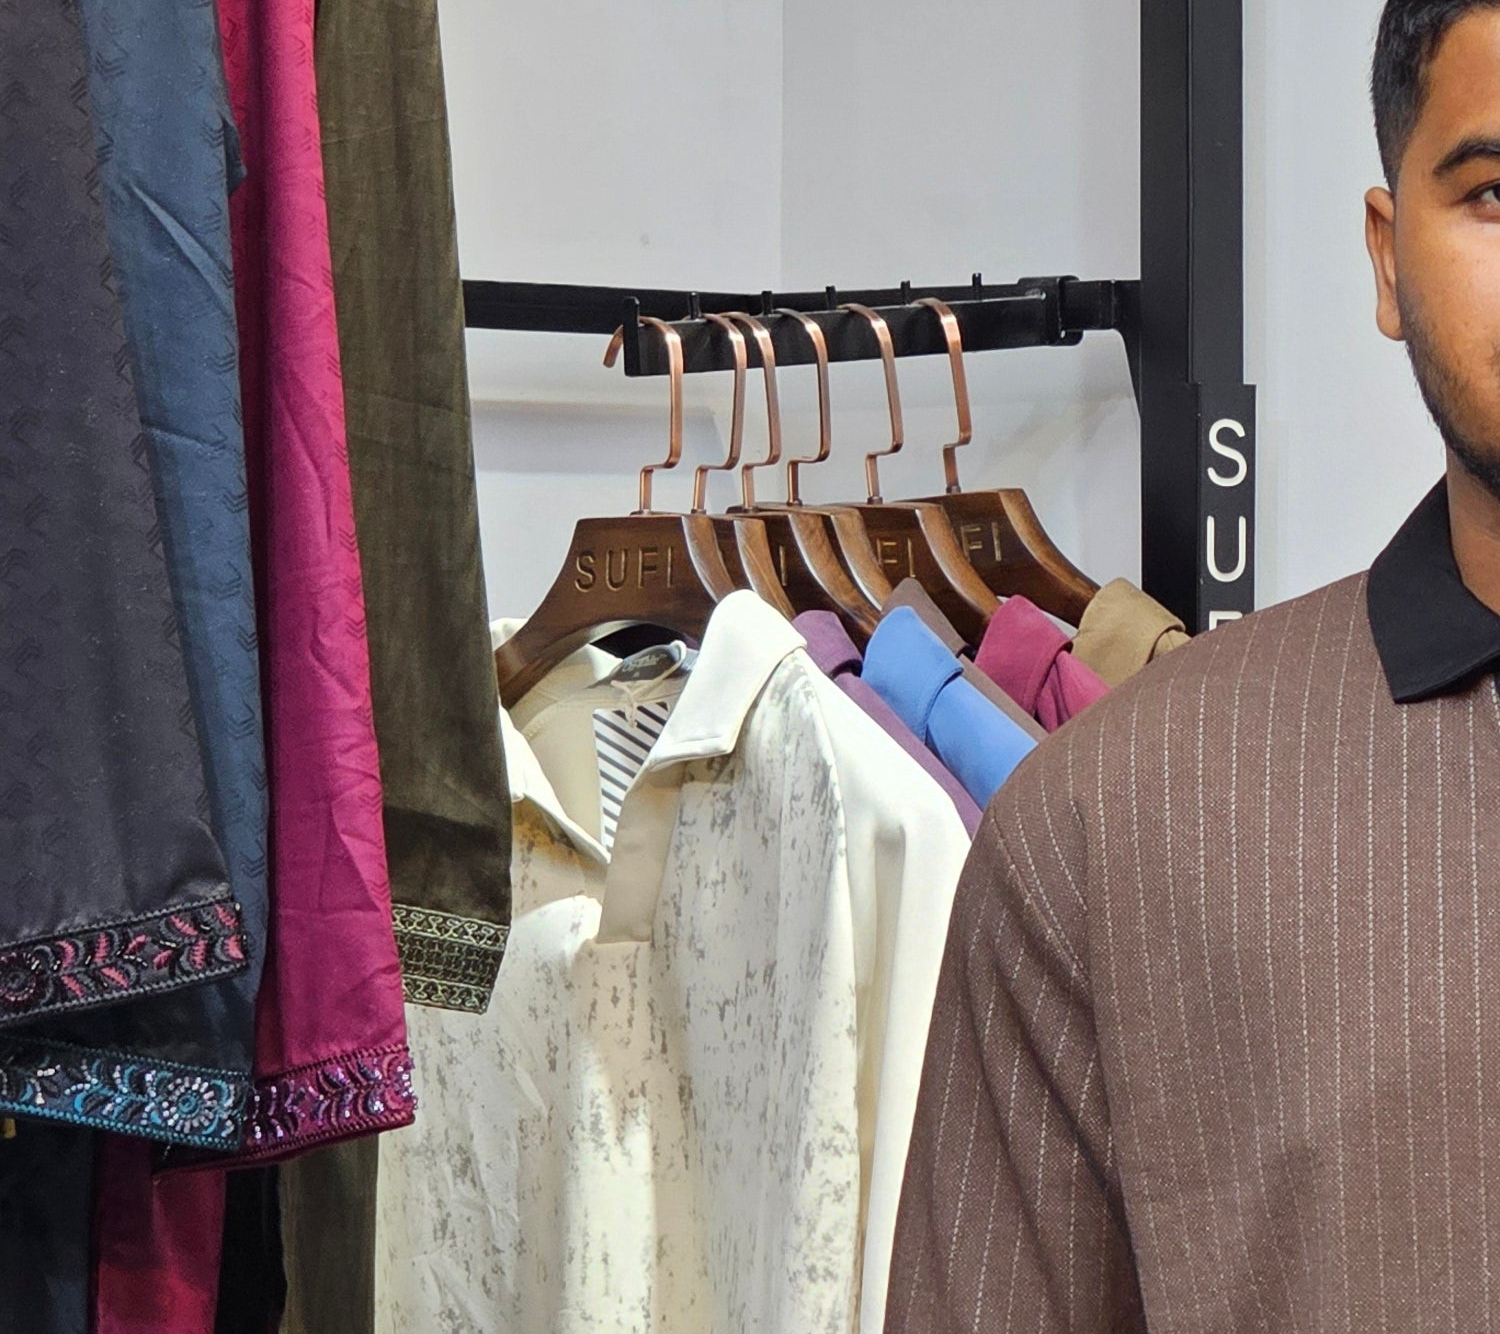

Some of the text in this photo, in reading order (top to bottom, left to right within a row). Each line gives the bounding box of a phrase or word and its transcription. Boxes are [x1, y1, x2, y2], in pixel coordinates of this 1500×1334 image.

[960, 521, 1003, 562] FI
[1206, 417, 1248, 631] SU
[573, 544, 676, 593] SUFI
[876, 536, 917, 578] FI
